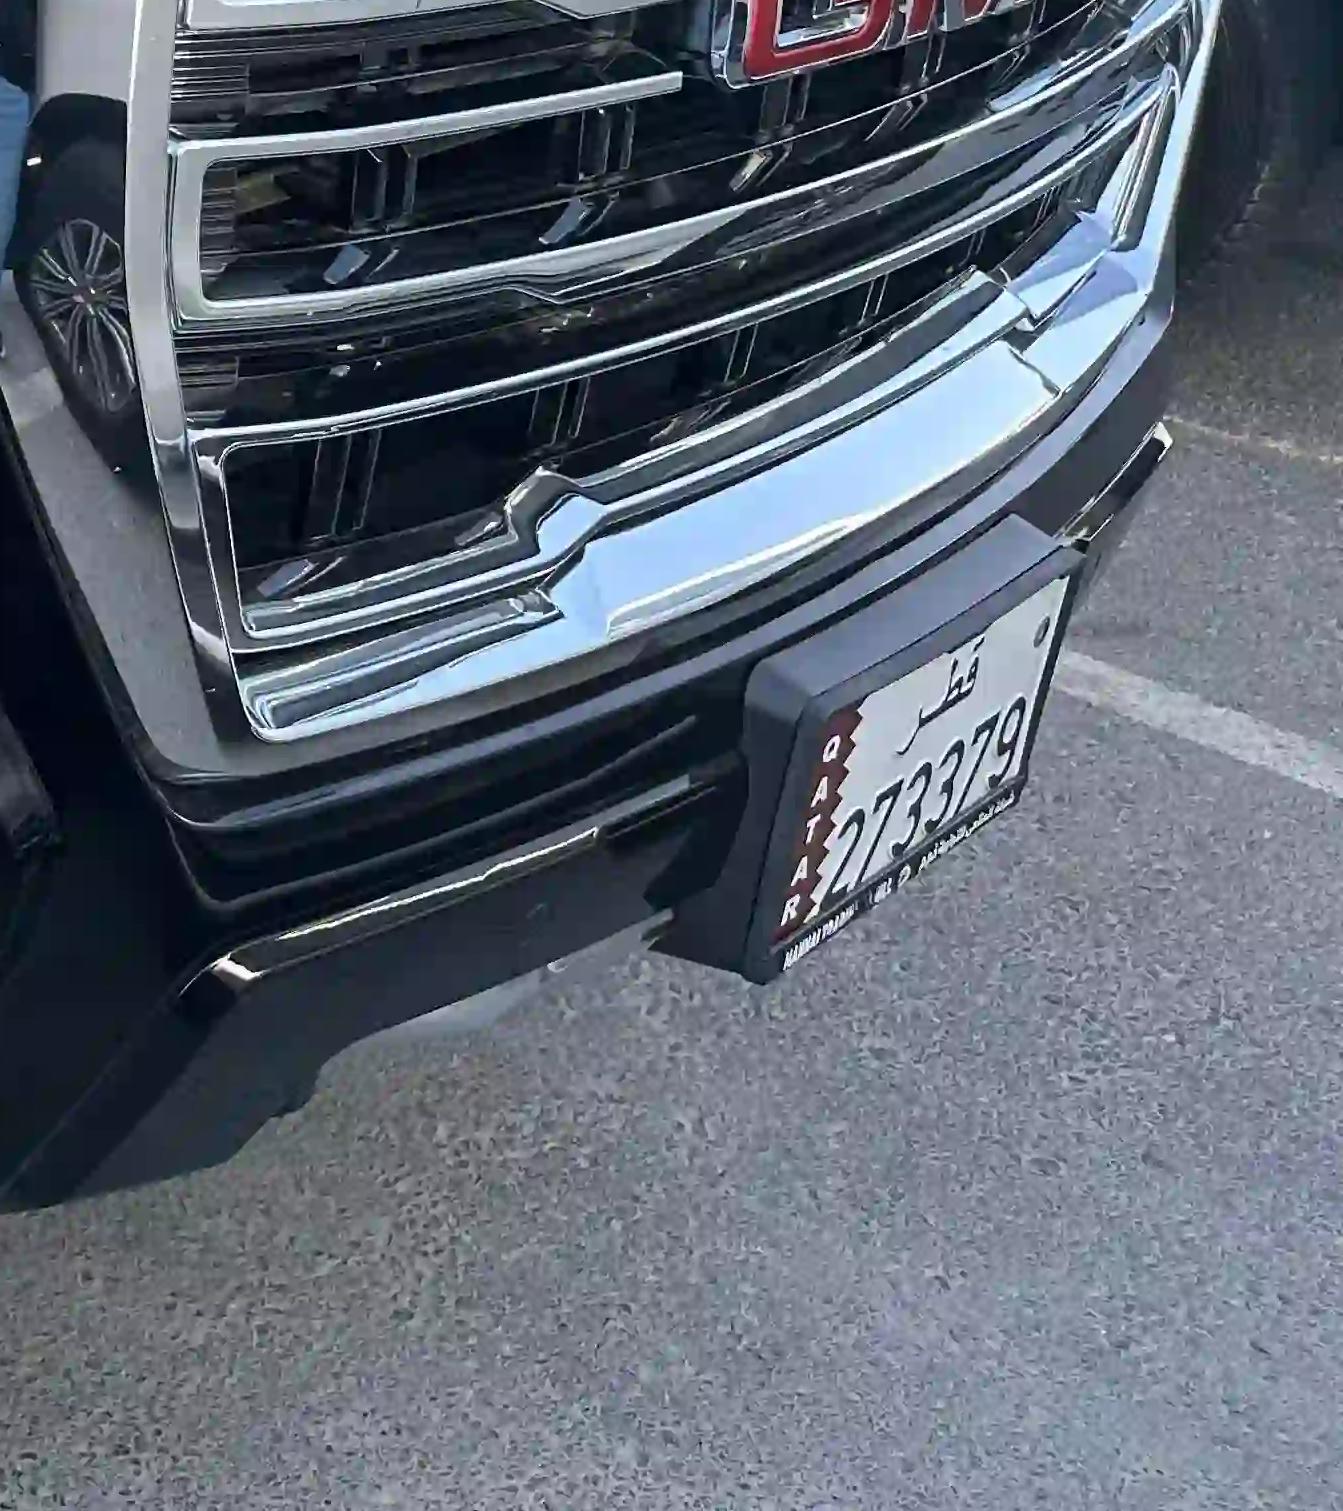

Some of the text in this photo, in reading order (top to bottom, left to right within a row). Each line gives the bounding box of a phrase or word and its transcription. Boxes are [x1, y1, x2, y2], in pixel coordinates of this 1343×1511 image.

[894, 633, 986, 757] قطر
[780, 734, 842, 927] QATAR
[823, 695, 1027, 906] 273379
